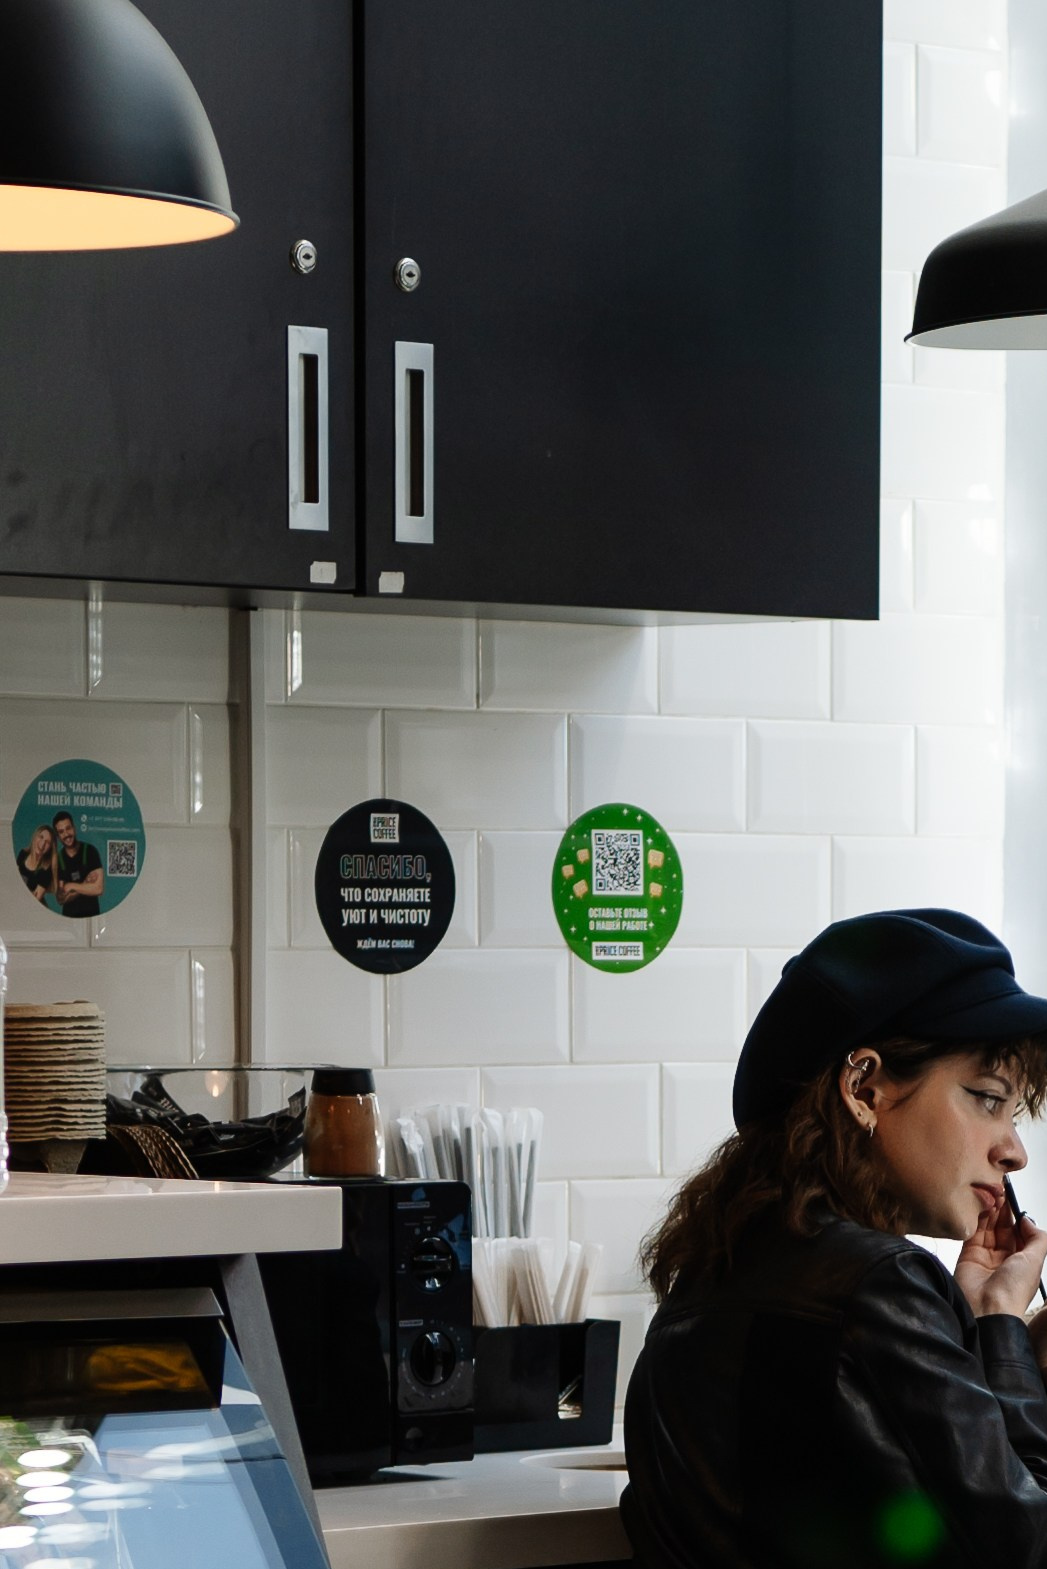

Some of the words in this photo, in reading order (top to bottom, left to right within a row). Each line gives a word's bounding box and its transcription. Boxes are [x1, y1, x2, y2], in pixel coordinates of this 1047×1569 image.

[37, 781, 67, 793] СТАНЬ
[69, 782, 107, 794] ЧАСТЬЮ
[37, 793, 71, 806] НАШЕЙ
[73, 795, 123, 809] КОМАНДЫ
[340, 854, 432, 883] СПАСИБО,
[340, 887, 362, 902] ЧТО
[364, 887, 431, 902] СОХРАНЯЕТЕ
[341, 908, 367, 927] УЮТ
[369, 908, 378, 924] И
[380, 908, 431, 927] ЧИСТОТУ
[621, 920, 648, 931] РАБОТЕ
[377, 939, 391, 949] ВАС
